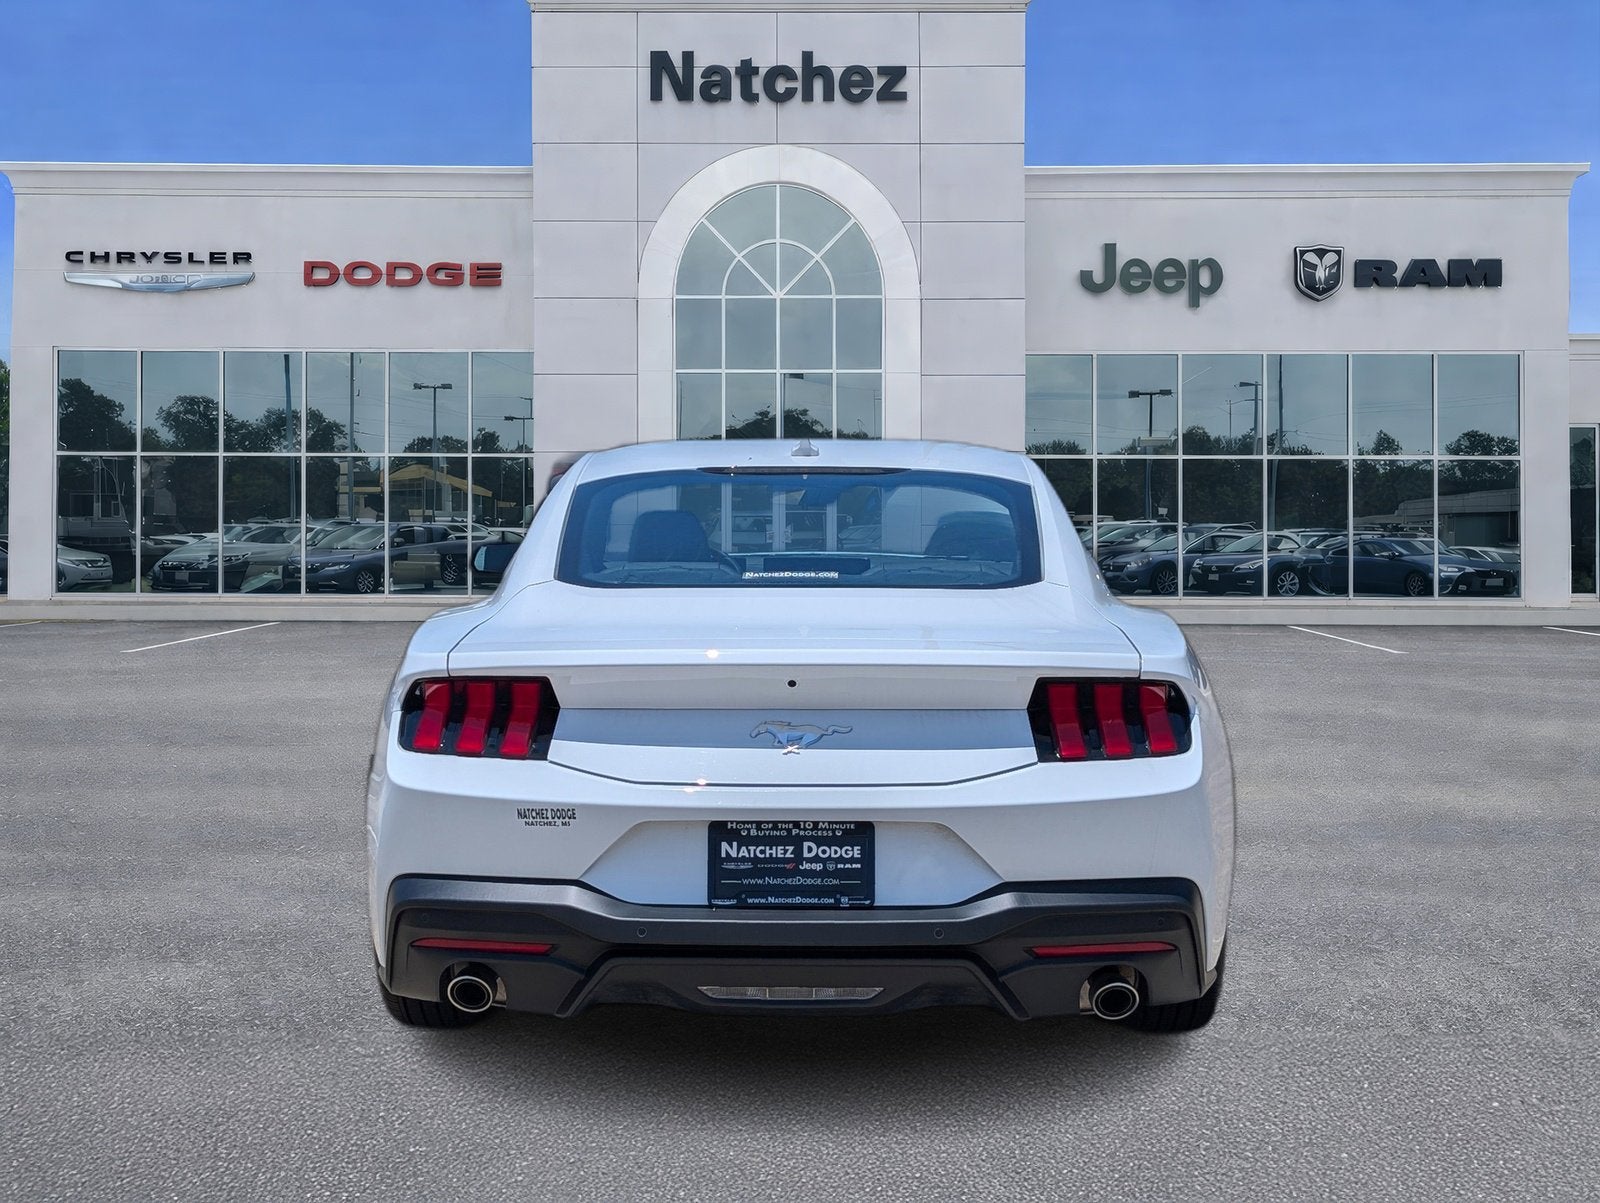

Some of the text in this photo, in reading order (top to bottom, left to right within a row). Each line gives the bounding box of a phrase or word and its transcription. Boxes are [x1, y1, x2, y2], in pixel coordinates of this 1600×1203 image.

[650, 50, 908, 104] Natchez
[65, 250, 253, 265] CHRYSLER
[303, 260, 502, 287] DODGE
[1079, 242, 1224, 309] Jeep
[1353, 258, 1503, 288] RAM
[744, 571, 839, 579] NATCHEZDODGE.COM
[516, 808, 577, 820] NATCHEZ DODGE
[727, 821, 757, 829] HOME
[799, 821, 814, 829] 10
[818, 821, 855, 829] MINUTE
[721, 841, 862, 858] NATCHEZ DODGE
[798, 860, 824, 872] Jeep
